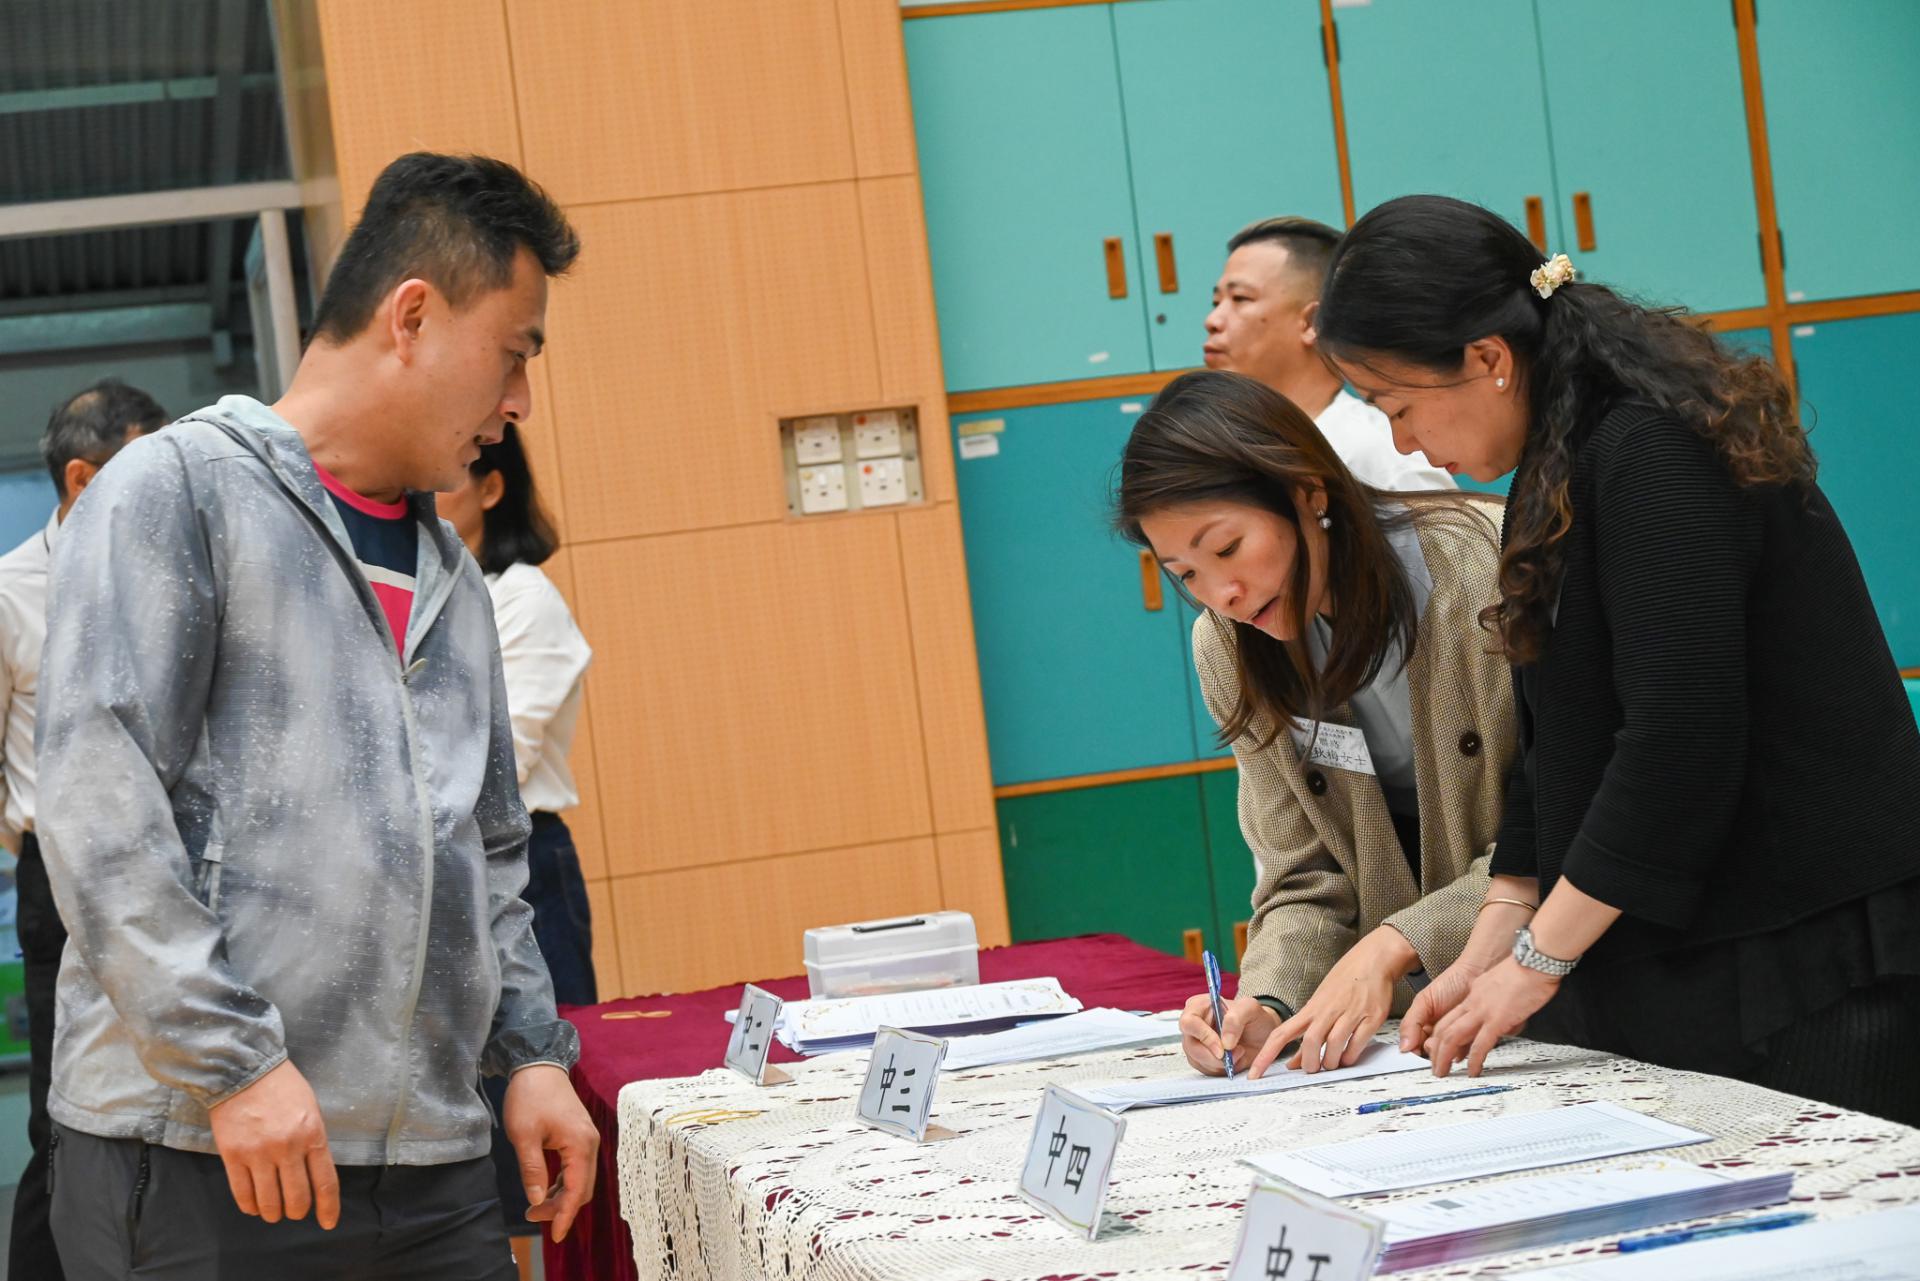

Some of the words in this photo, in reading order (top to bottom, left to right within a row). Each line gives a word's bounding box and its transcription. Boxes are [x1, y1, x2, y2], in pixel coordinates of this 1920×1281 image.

[739, 1003, 762, 1057] 中二
[878, 1053, 915, 1115] 中三
[1044, 1114, 1091, 1195] 中四
